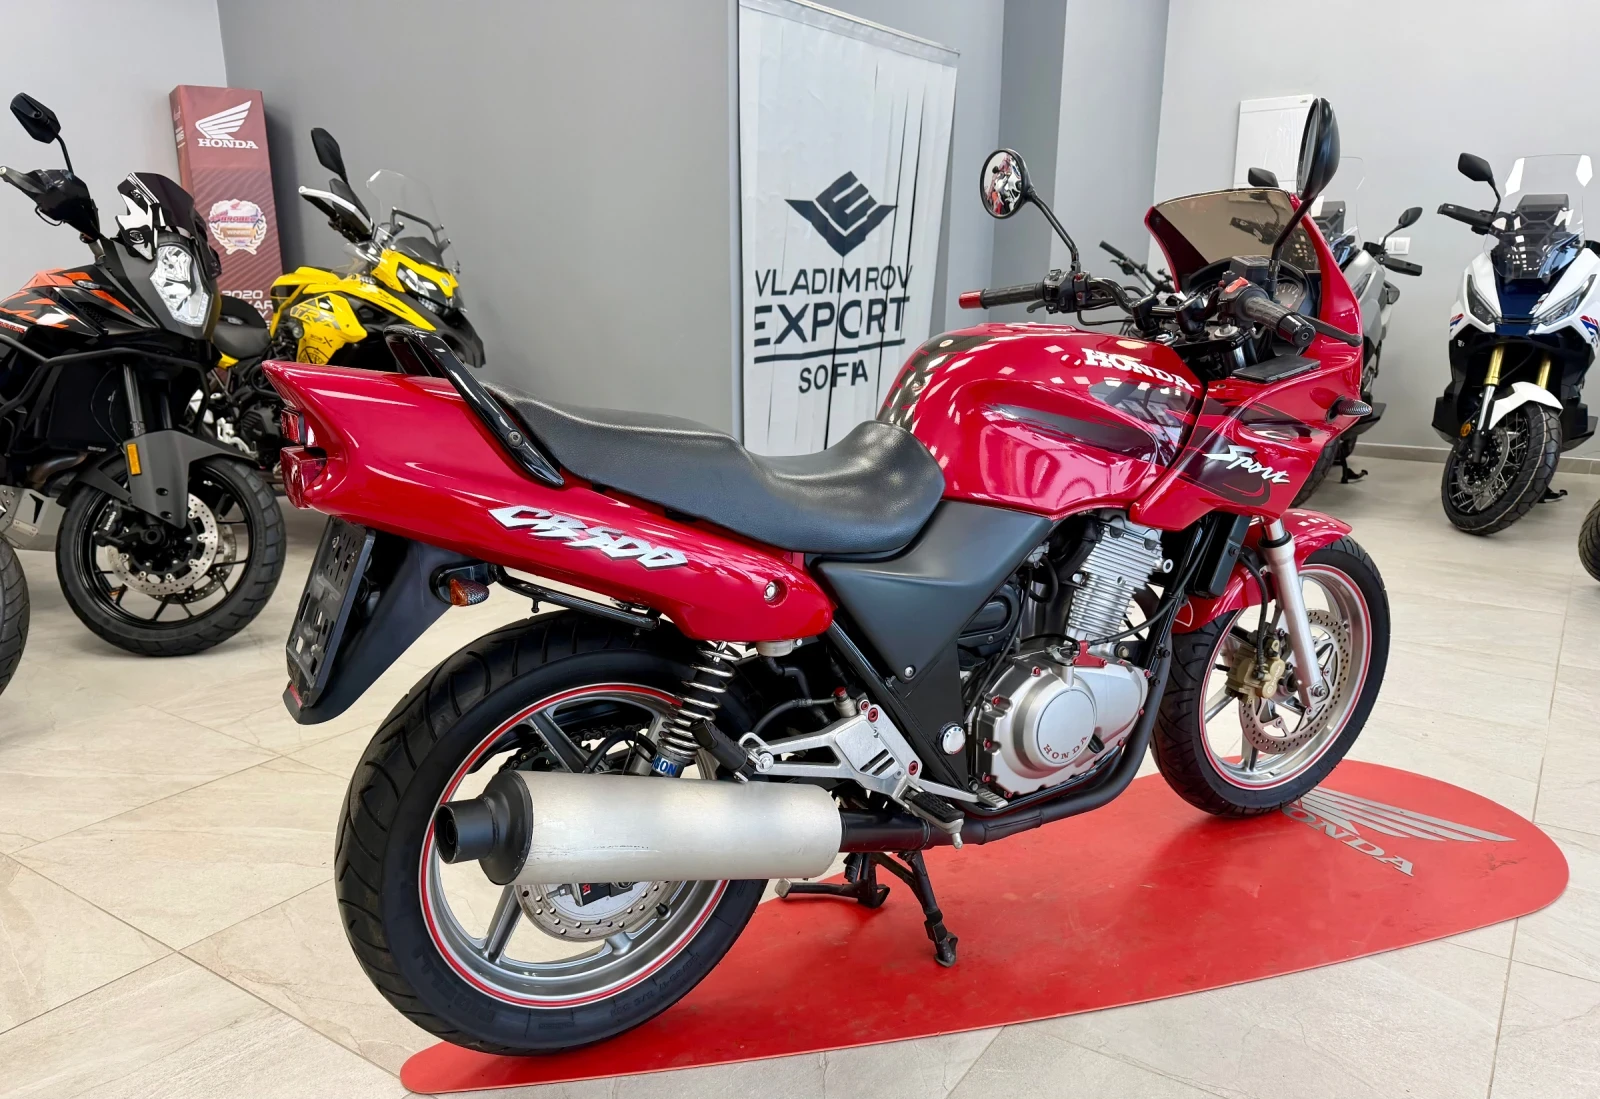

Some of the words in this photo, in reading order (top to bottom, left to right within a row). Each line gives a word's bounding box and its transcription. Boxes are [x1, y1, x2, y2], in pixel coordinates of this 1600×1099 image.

[197, 138, 259, 150] HONDA
[754, 296, 910, 347] EXPORT
[1081, 347, 1195, 392] HONDA
[1201, 444, 1291, 484] Sport
[1043, 735, 1089, 760] HONDA
[1281, 805, 1414, 877] ONDA
